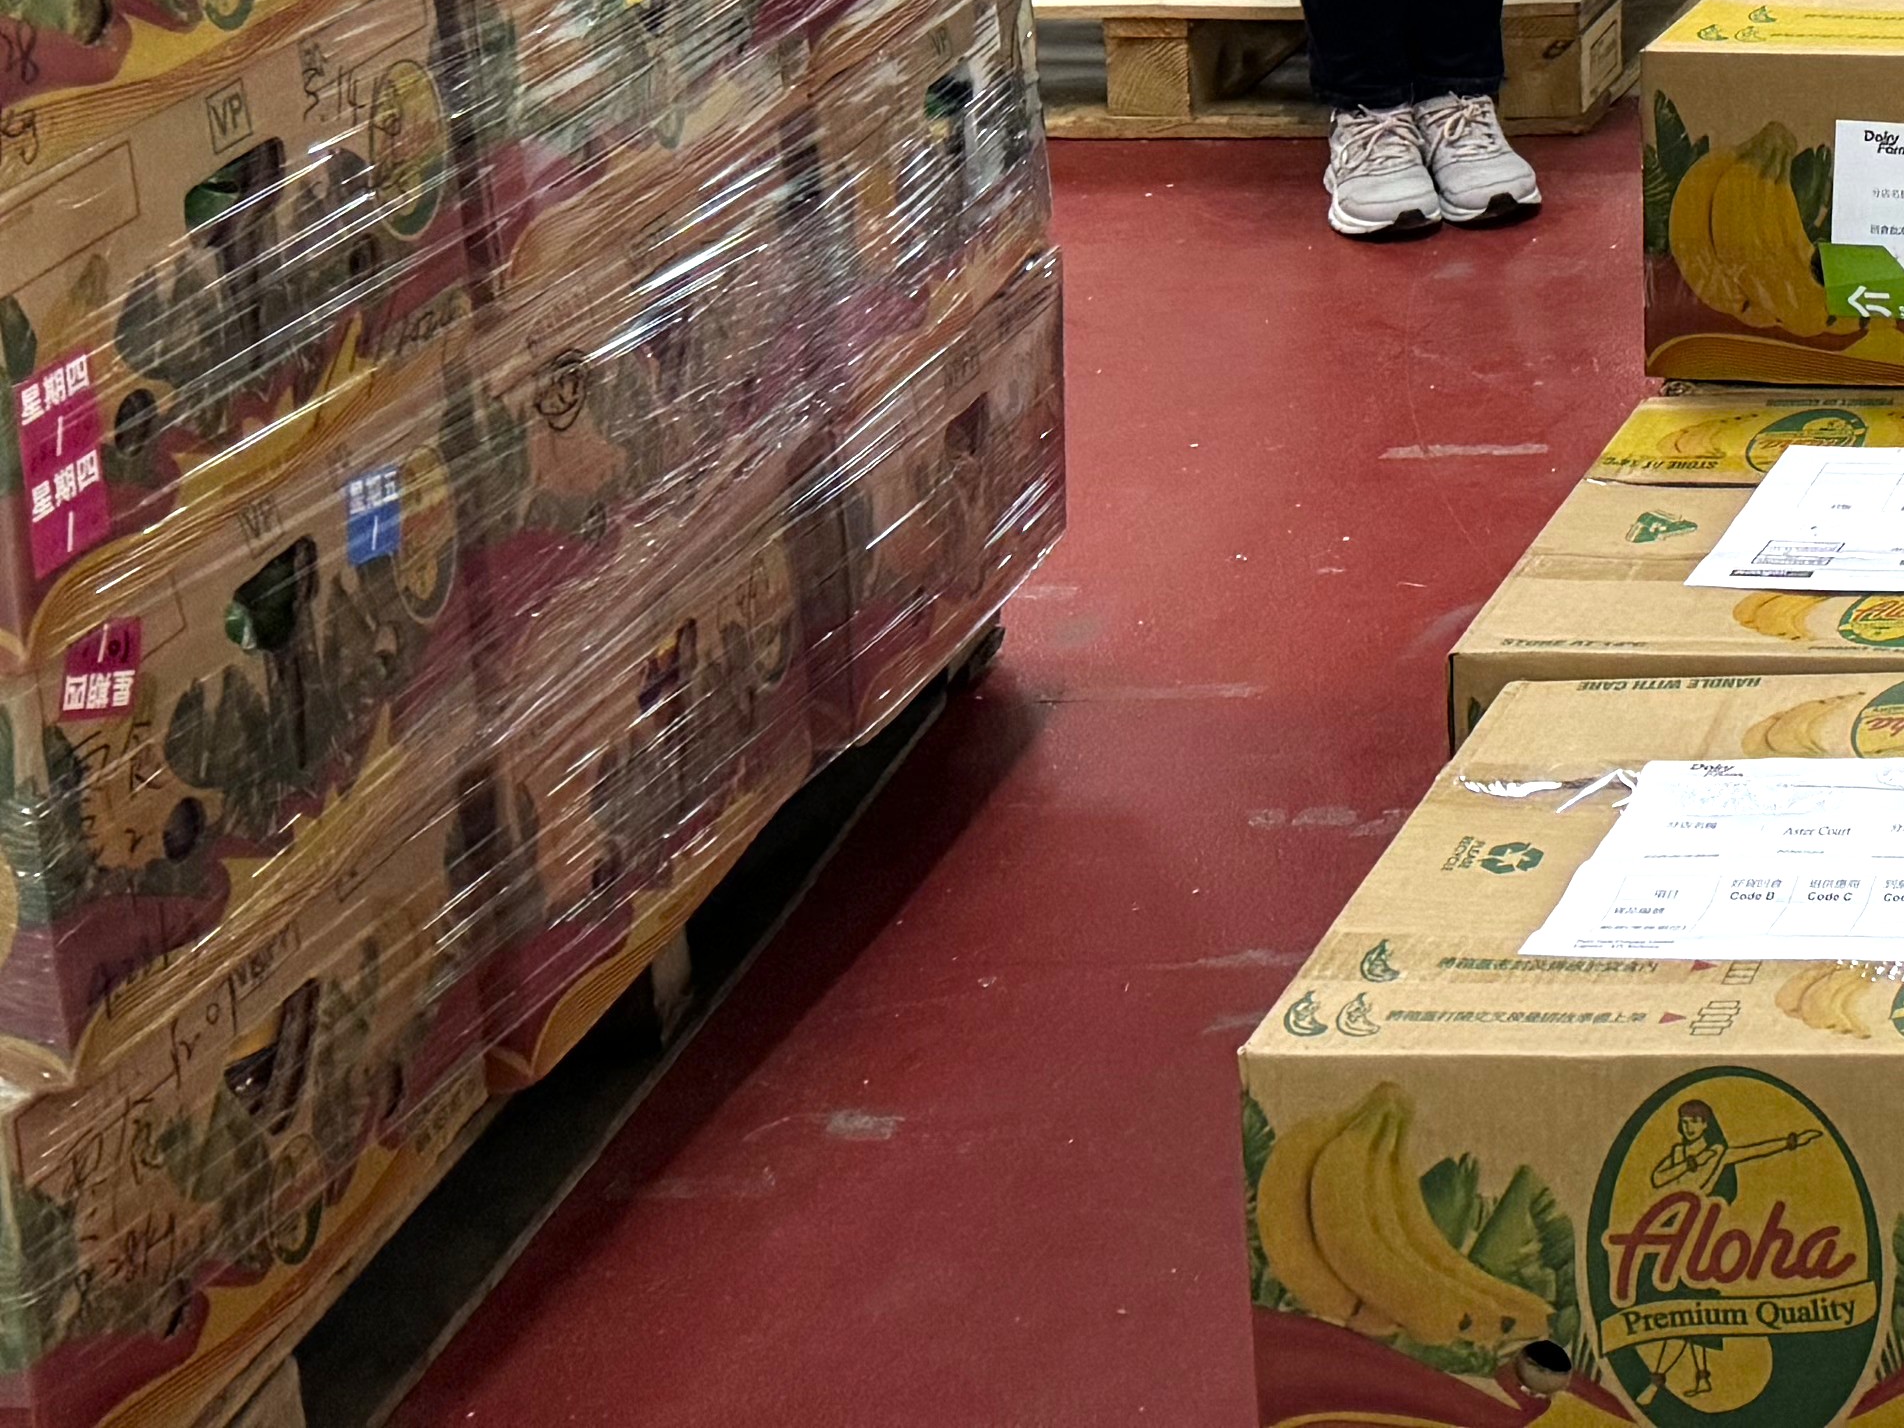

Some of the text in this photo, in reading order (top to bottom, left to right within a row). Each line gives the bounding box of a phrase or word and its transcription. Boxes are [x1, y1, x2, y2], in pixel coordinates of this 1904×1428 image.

[209, 97, 243, 138] VP
[1863, 129, 1899, 145] Dairy
[20, 355, 91, 428] 星期四
[31, 449, 101, 523] 星期四
[1576, 677, 1760, 691] HANDLE WITH CARE
[1689, 762, 1736, 774] Dairy
[1818, 825, 1852, 837] Court
[1729, 891, 1762, 902] Code
[1807, 891, 1838, 903] Code
[1841, 892, 1853, 903] C
[1606, 1190, 1857, 1303] Aloha
[1623, 1293, 1857, 1337] Premium Quality
